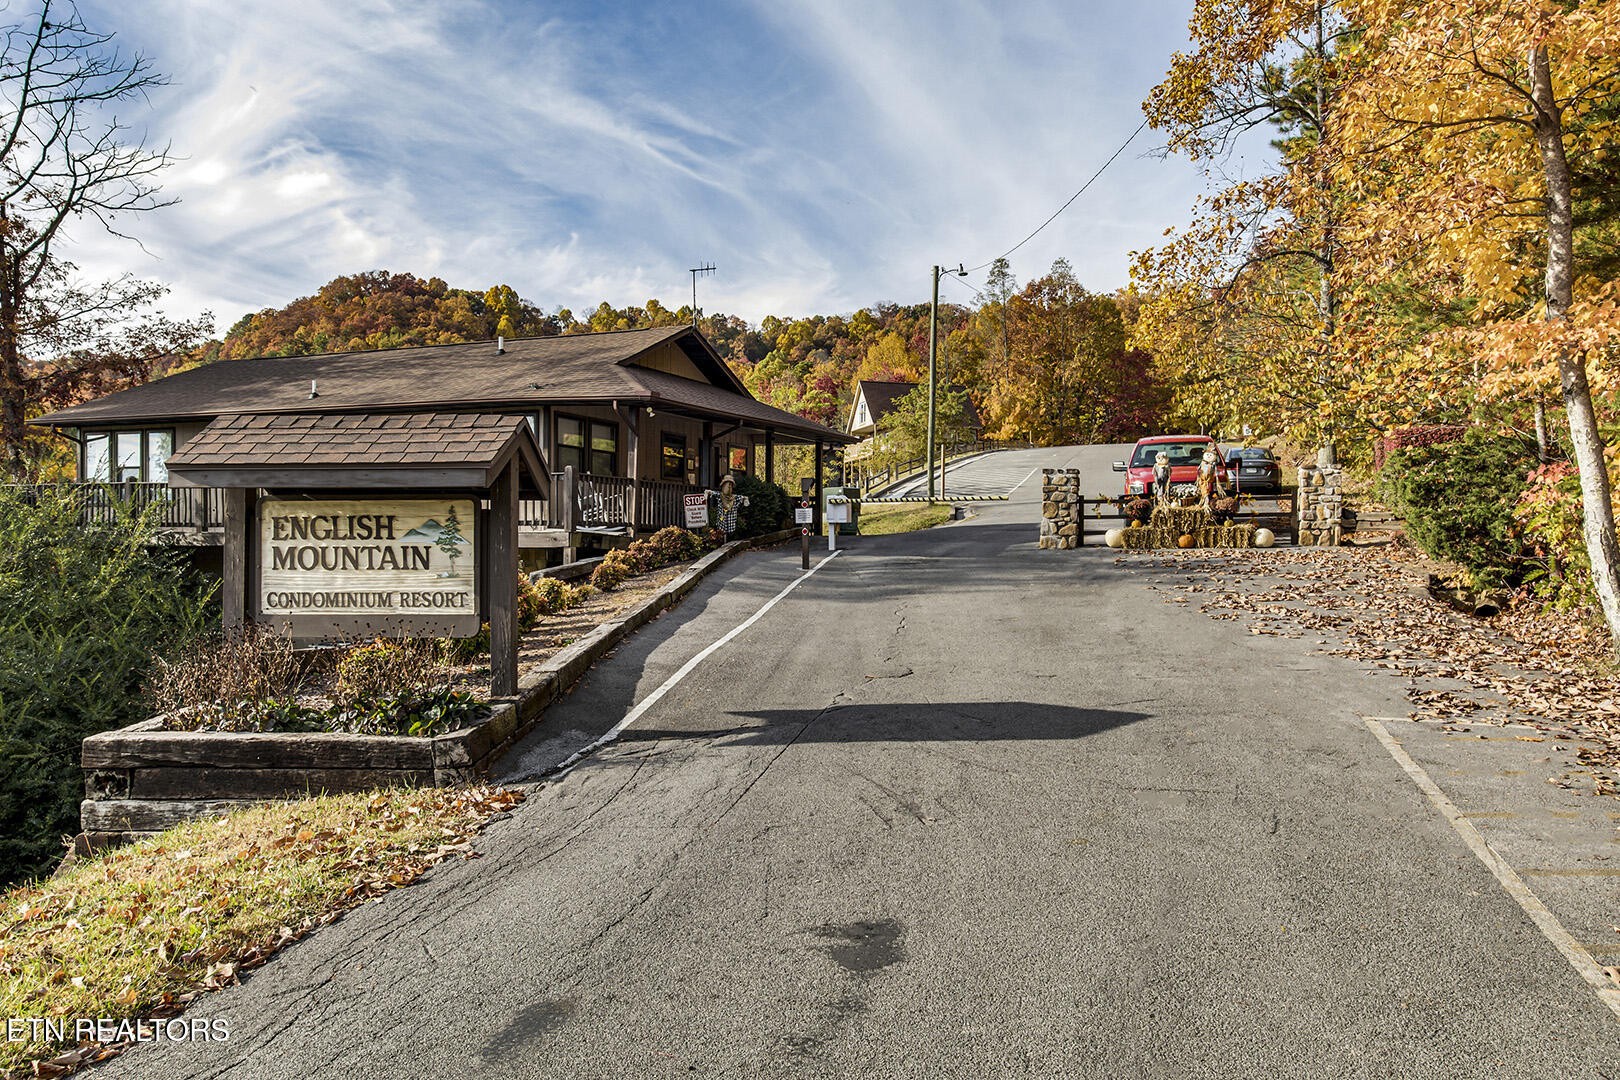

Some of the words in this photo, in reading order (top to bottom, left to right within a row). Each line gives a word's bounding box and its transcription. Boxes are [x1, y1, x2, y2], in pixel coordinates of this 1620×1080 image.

[685, 496, 705, 505] STOP
[272, 515, 396, 540] ENGLISH
[272, 545, 431, 571] MOUNTAIN
[266, 591, 393, 608] CONDOMINIUM
[399, 591, 469, 608] RESORT
